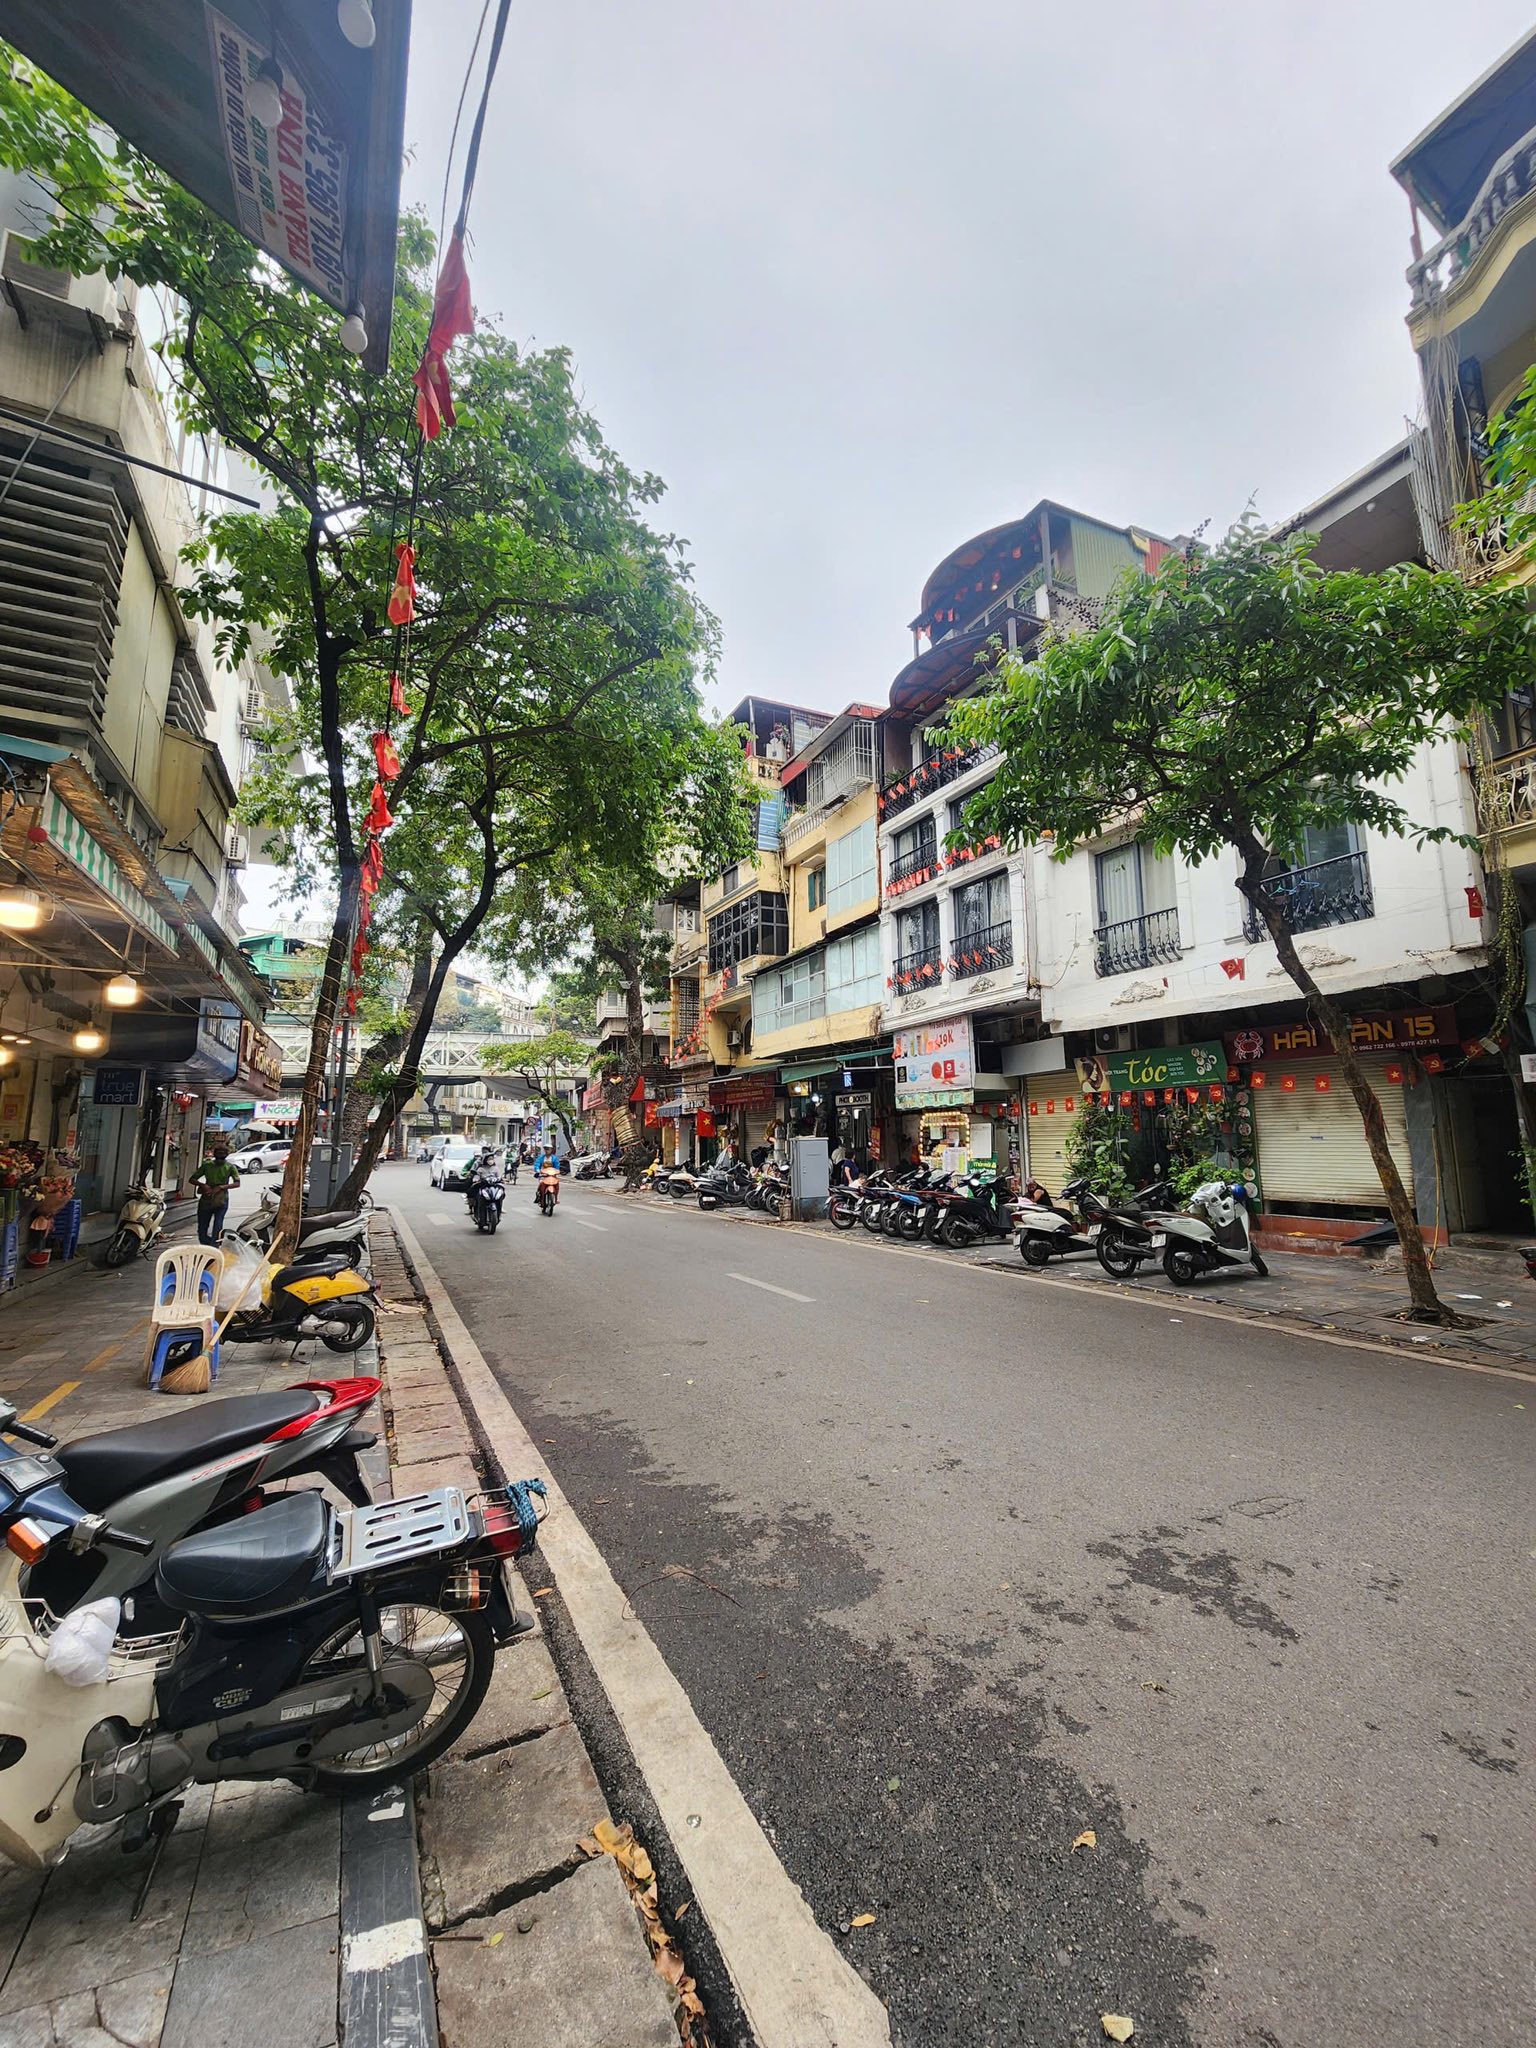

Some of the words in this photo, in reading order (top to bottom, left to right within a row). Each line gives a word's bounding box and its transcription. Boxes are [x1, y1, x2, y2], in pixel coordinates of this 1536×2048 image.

[226, 88, 245, 118] DI
[276, 85, 303, 171] VINH
[1273, 1025, 1317, 1050] HẢI
[1351, 1018, 1394, 1043] ẢN
[1403, 1015, 1436, 1037] 15
[99, 1092, 134, 1103] mart
